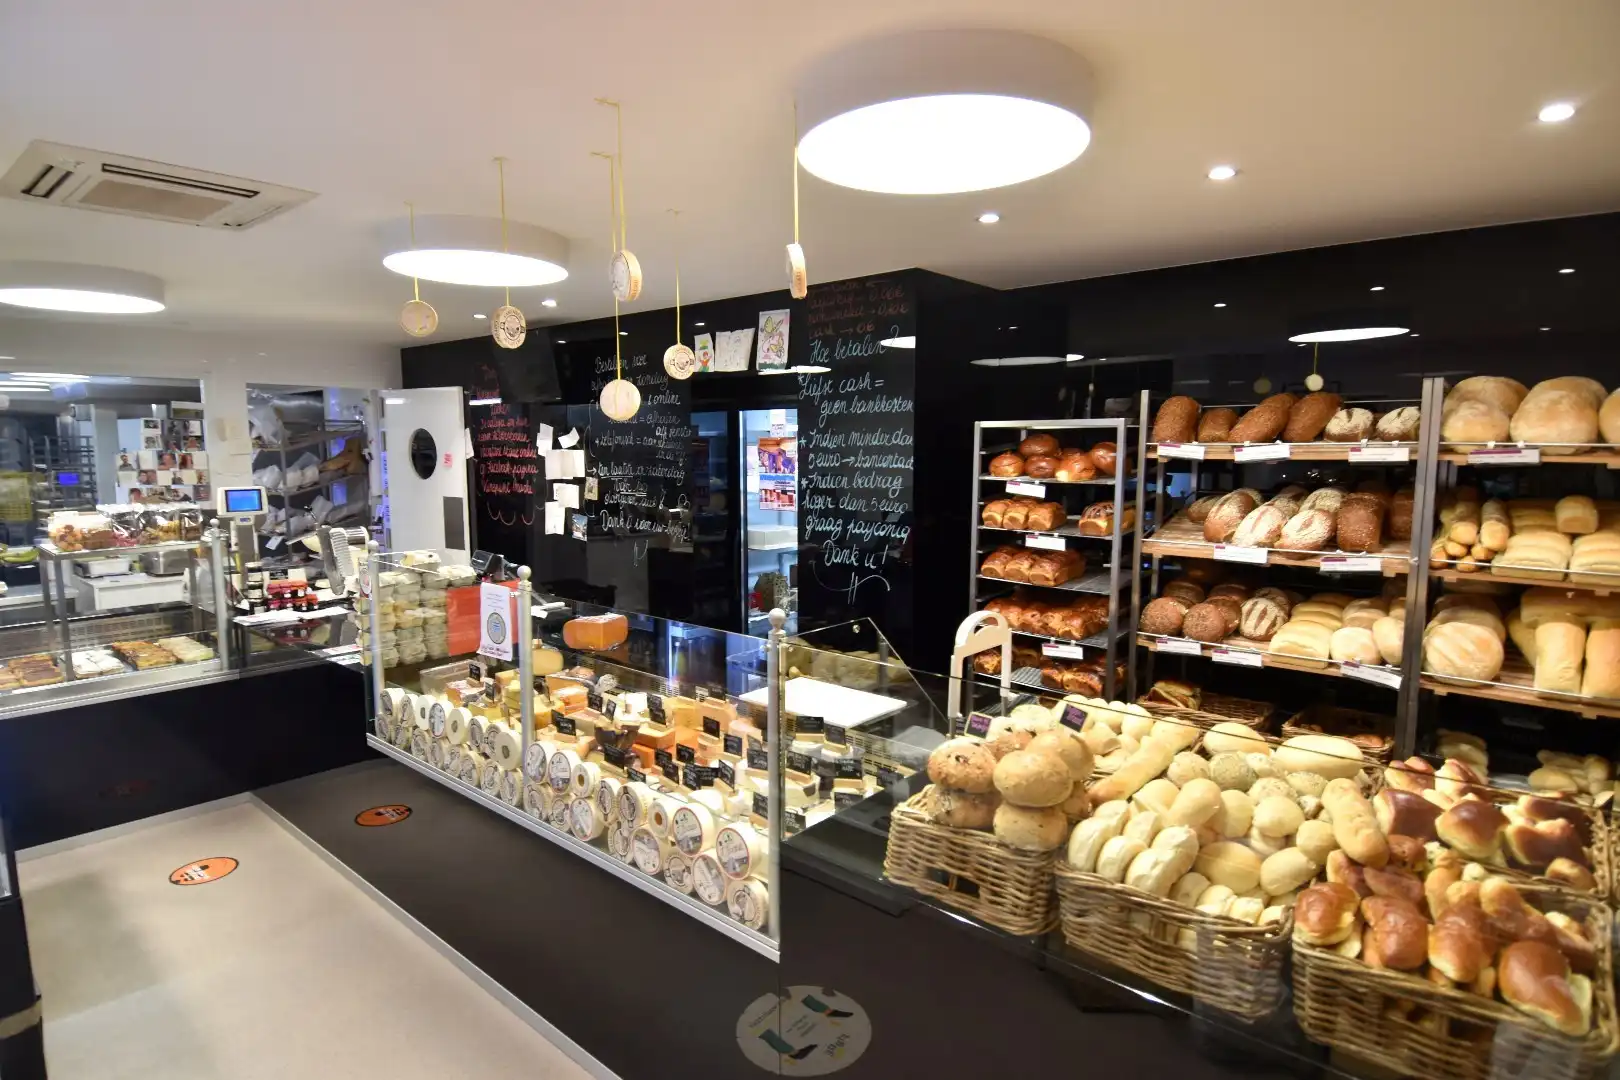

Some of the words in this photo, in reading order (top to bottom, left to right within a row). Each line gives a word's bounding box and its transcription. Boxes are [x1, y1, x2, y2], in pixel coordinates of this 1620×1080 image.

[809, 339, 830, 364] Hoe
[833, 334, 887, 360] betalen
[838, 372, 872, 394] cash
[818, 399, 848, 428] geen
[849, 394, 914, 416] bankkosten
[809, 428, 845, 449] Indien
[848, 428, 893, 447] minder
[808, 471, 851, 490] Indien
[852, 470, 905, 499] bedrag
[801, 491, 836, 518] hoger
[838, 492, 868, 513] dan
[879, 500, 909, 515] euro
[805, 515, 843, 541] graag
[846, 519, 911, 545] payconiq
[822, 539, 860, 567] Dank
